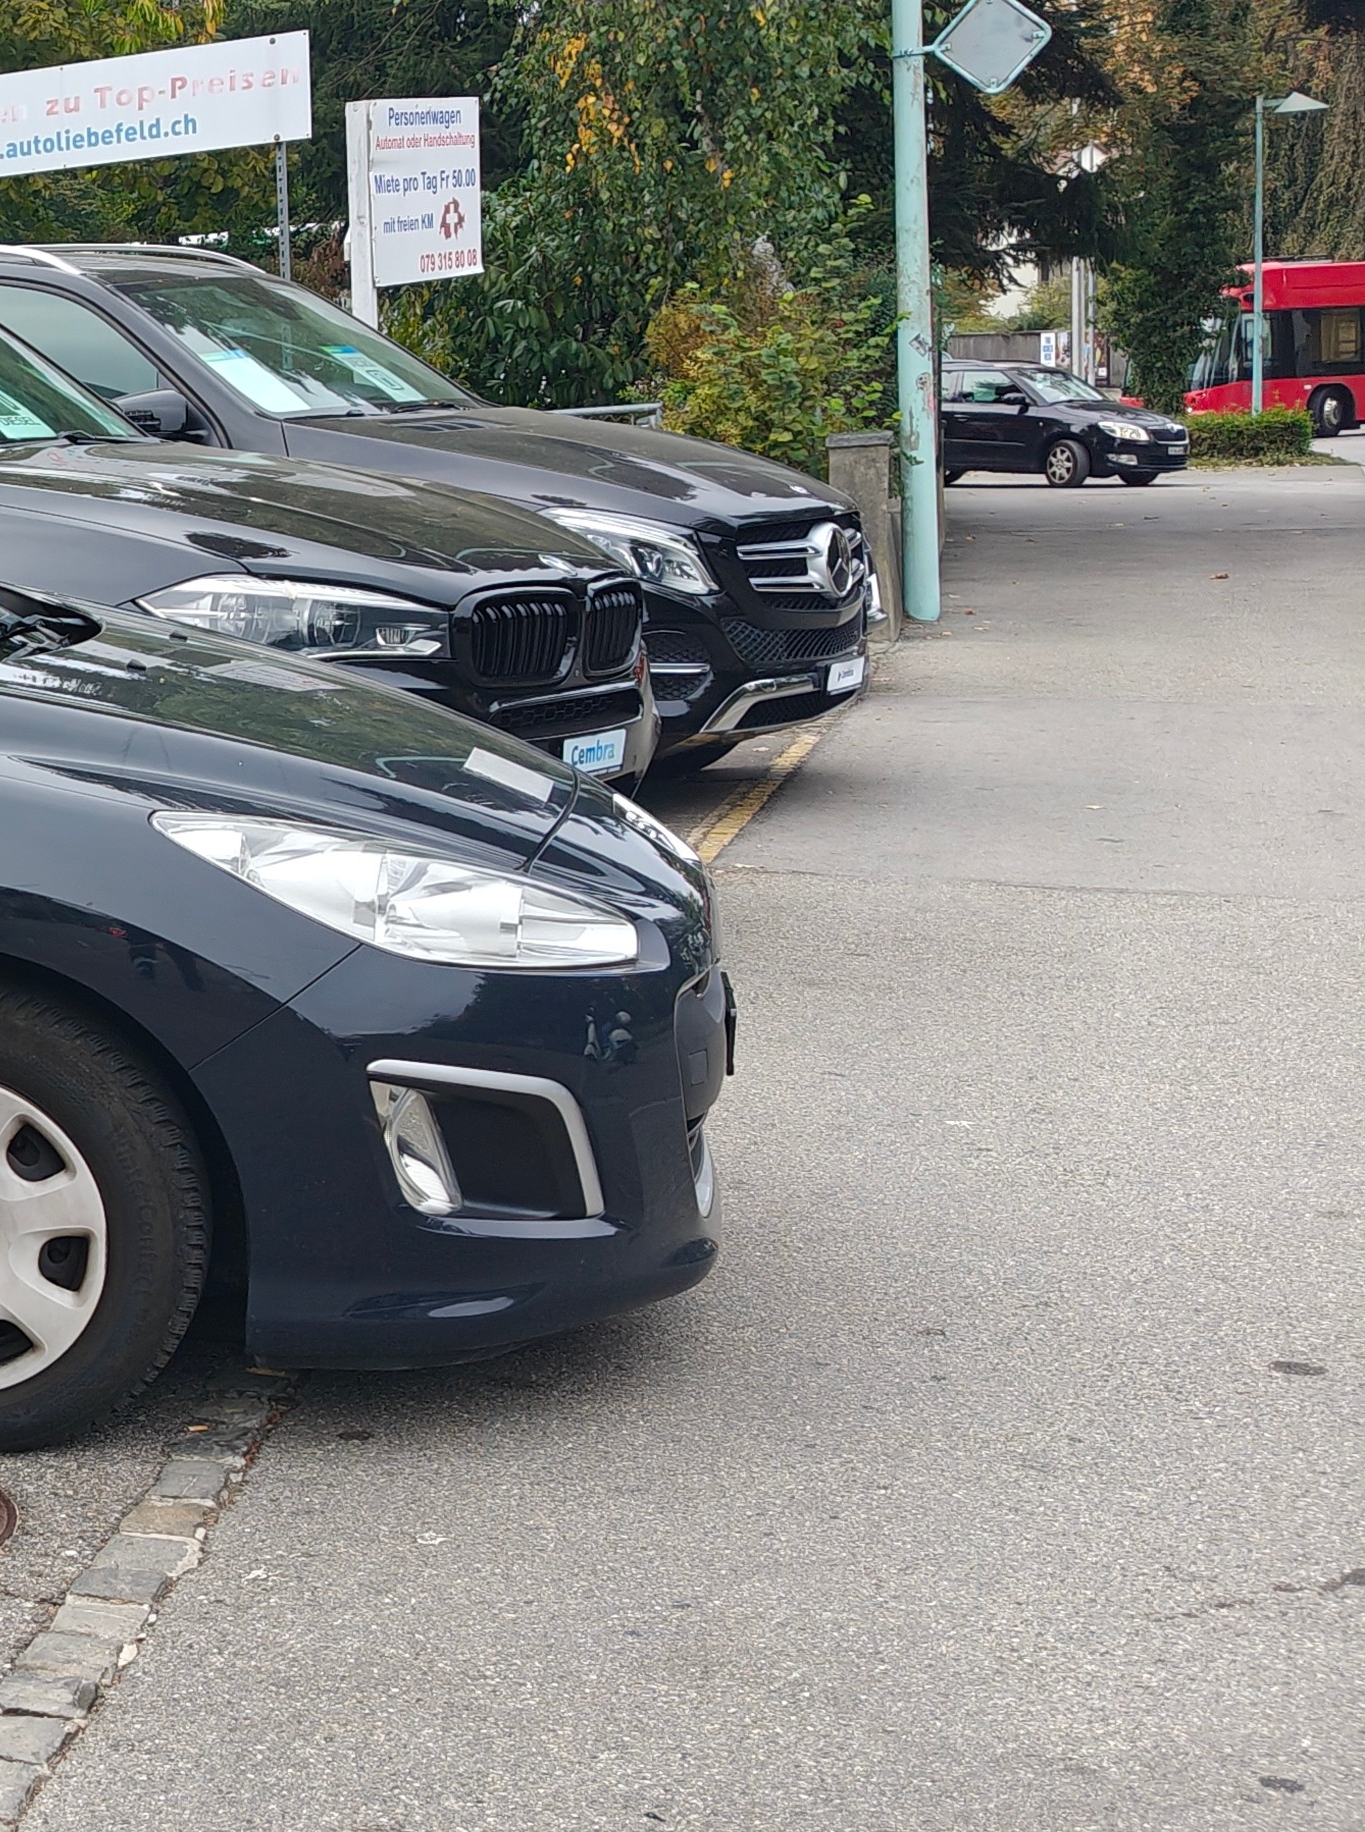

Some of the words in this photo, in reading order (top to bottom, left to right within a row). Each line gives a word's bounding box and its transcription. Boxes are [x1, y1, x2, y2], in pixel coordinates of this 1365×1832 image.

[44, 94, 81, 117] zu
[94, 66, 301, 111] Top-Preisen
[388, 107, 462, 130] Personenwagen
[375, 135, 405, 151] Automat
[405, 134, 422, 149] oder
[423, 132, 476, 149] Handschaltung
[374, 173, 401, 194] Miete
[402, 175, 419, 197] pro
[420, 171, 438, 195] Tag
[439, 170, 450, 190] Fr
[451, 168, 476, 188] 50.00
[383, 217, 397, 234] mit
[397, 215, 420, 233] freien
[420, 213, 434, 230] KM
[420, 253, 436, 273] 079
[437, 251, 453, 271] 315
[455, 250, 465, 269] 80
[467, 248, 478, 267] 08
[571, 739, 615, 766] Cembra
